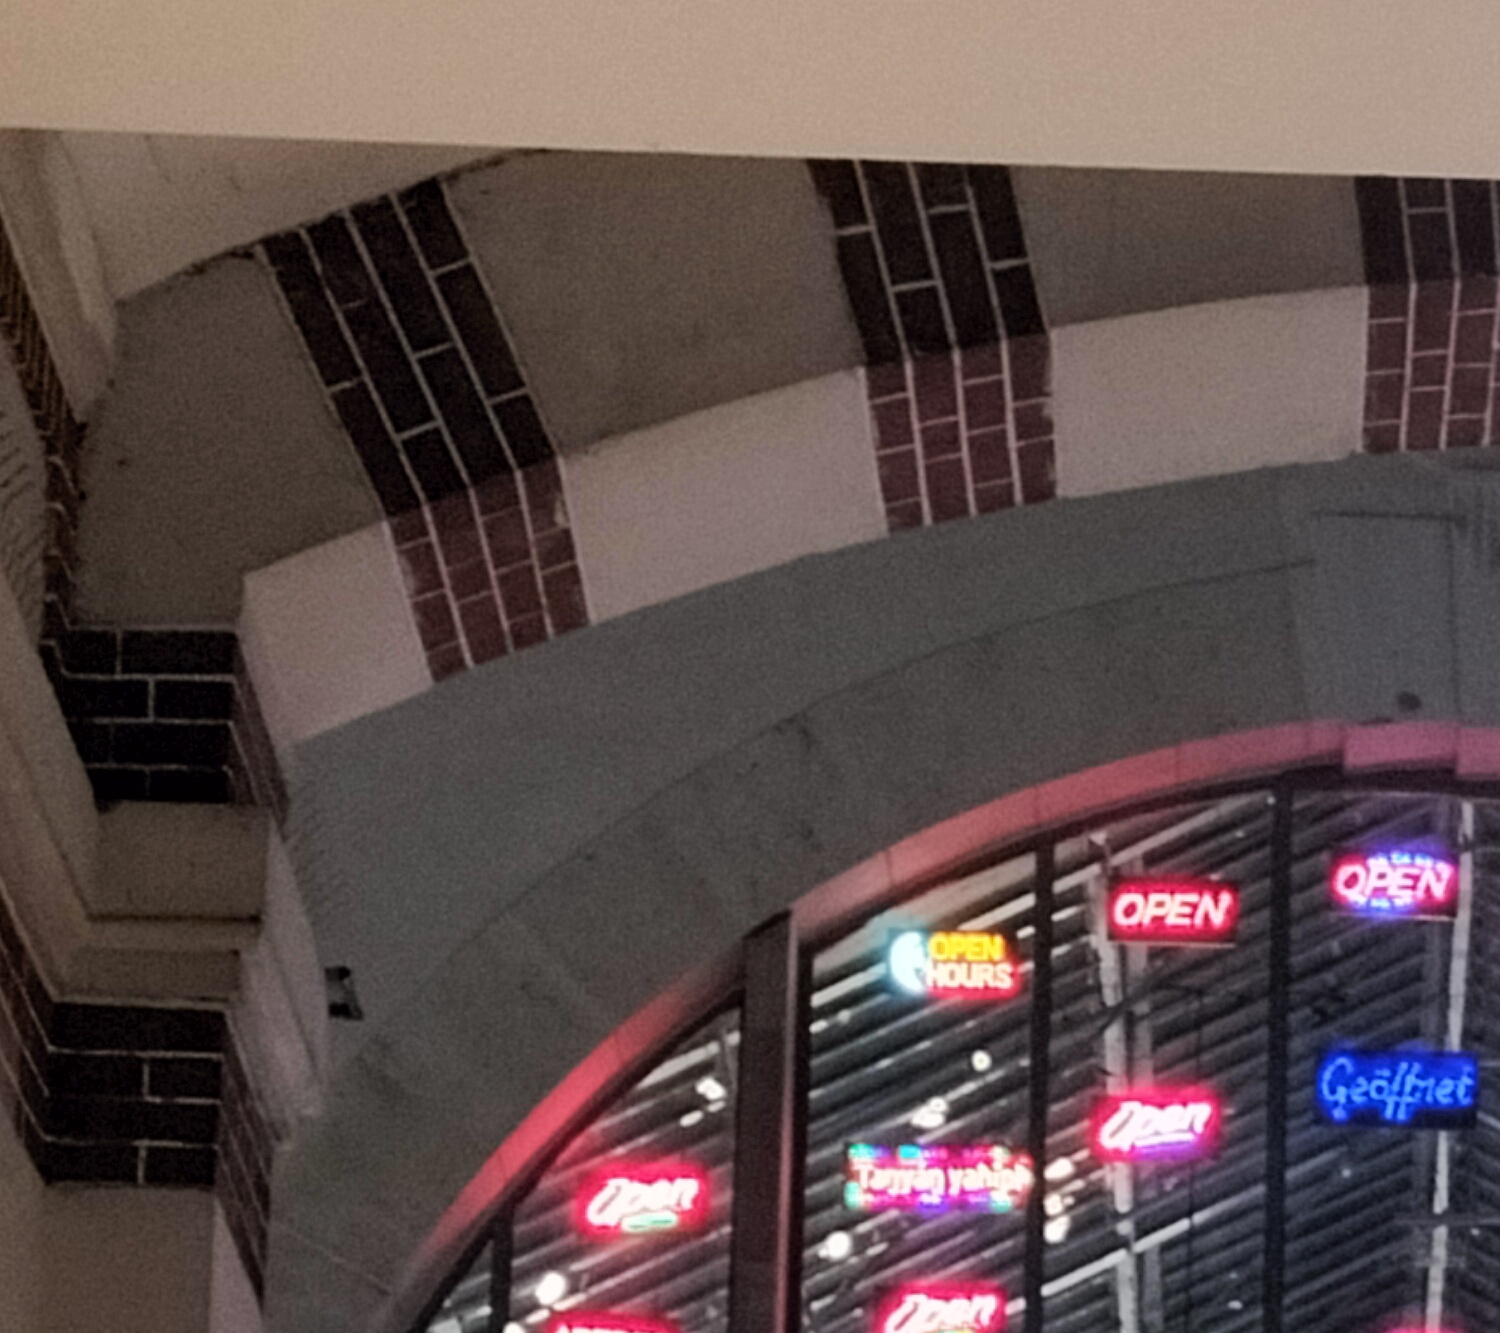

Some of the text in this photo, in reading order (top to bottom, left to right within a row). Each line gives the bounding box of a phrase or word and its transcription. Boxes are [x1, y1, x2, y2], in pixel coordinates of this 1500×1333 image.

[1337, 863, 1453, 900] OPEN
[1112, 892, 1233, 930] OPEN
[929, 932, 1005, 961] OPEN
[926, 962, 1013, 989] HOURS
[1100, 1101, 1213, 1151] Open
[587, 1177, 699, 1228] Open
